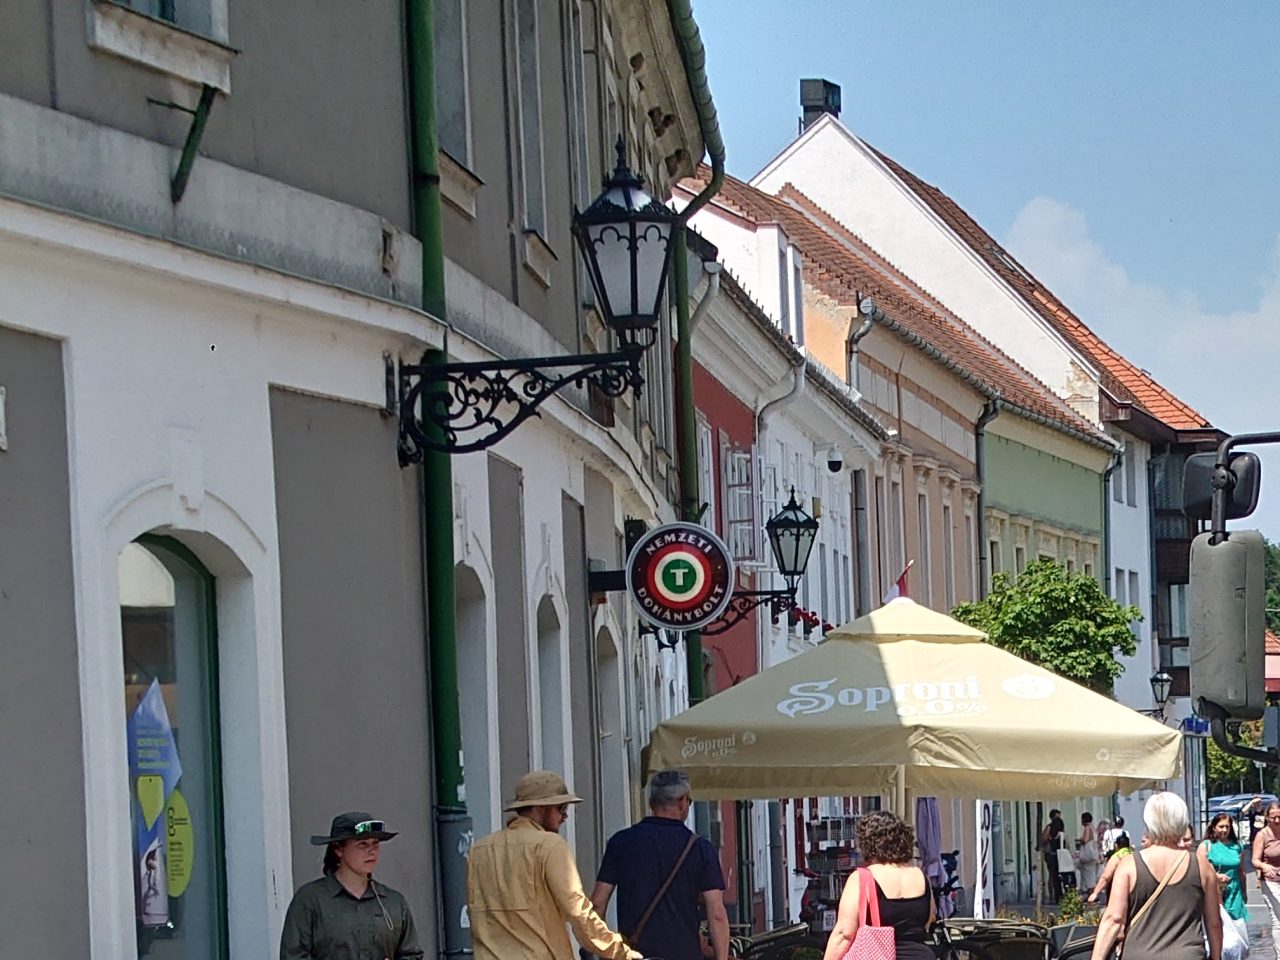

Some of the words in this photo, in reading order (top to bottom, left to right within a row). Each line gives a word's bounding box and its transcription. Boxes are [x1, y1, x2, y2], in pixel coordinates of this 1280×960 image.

[646, 533, 712, 555] NEMZETI
[670, 569, 688, 586] T
[637, 584, 724, 622] DOHÁNYBOLT
[776, 675, 981, 719] Soproni
[681, 733, 736, 758] Soproni
